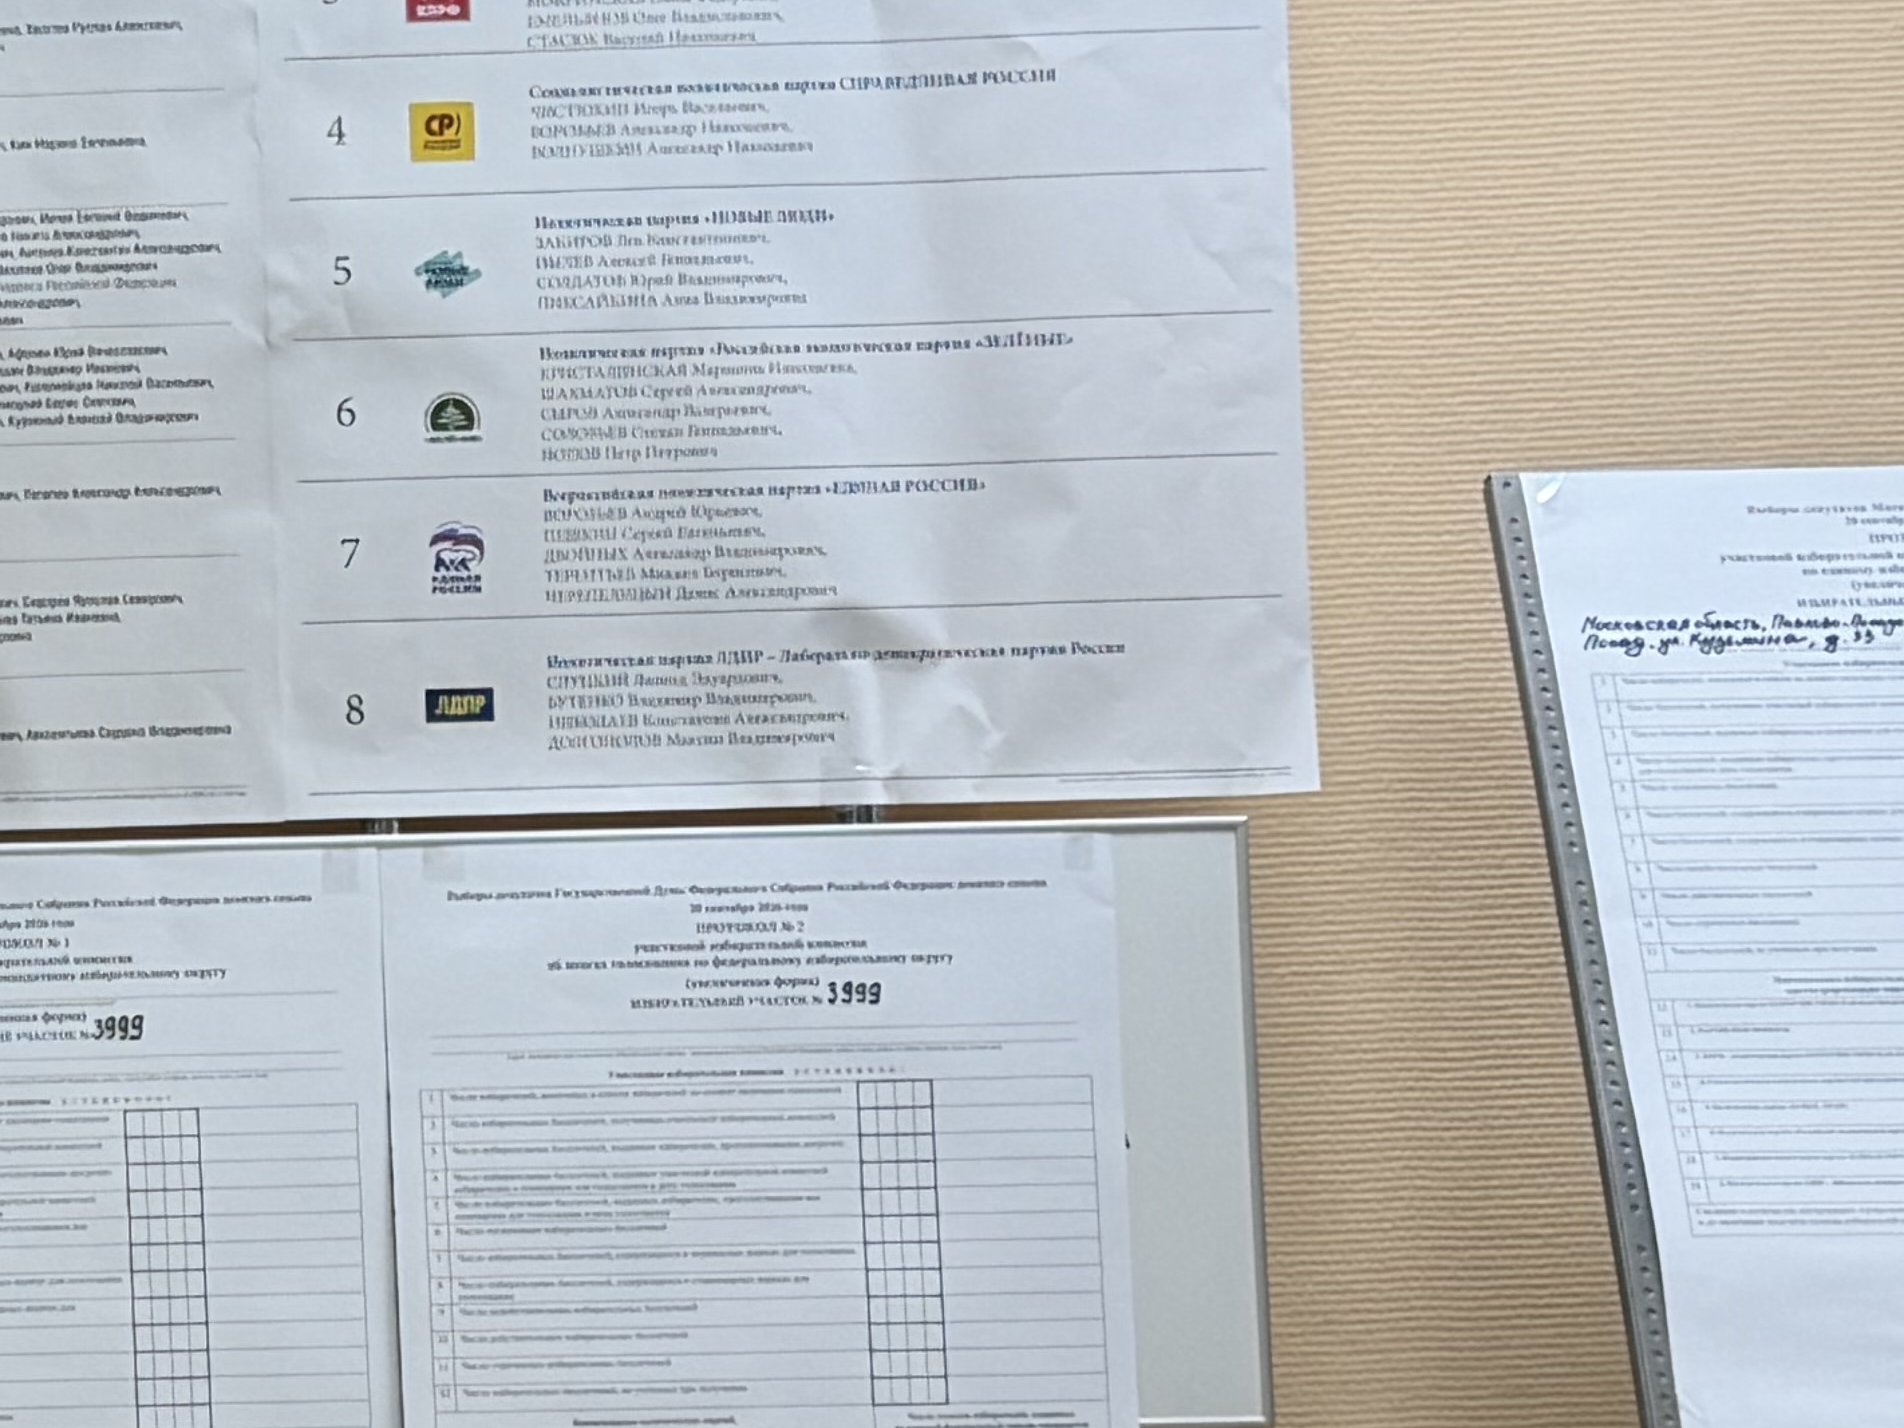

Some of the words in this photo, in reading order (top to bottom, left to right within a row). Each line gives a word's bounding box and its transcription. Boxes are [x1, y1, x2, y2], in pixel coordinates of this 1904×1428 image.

[327, 116, 345, 145] 4
[334, 256, 351, 285] 5
[337, 397, 355, 426] 6
[341, 538, 360, 568] 7
[346, 694, 364, 725] 8
[828, 981, 881, 1005] 3999
[93, 1015, 144, 1040] 3999
